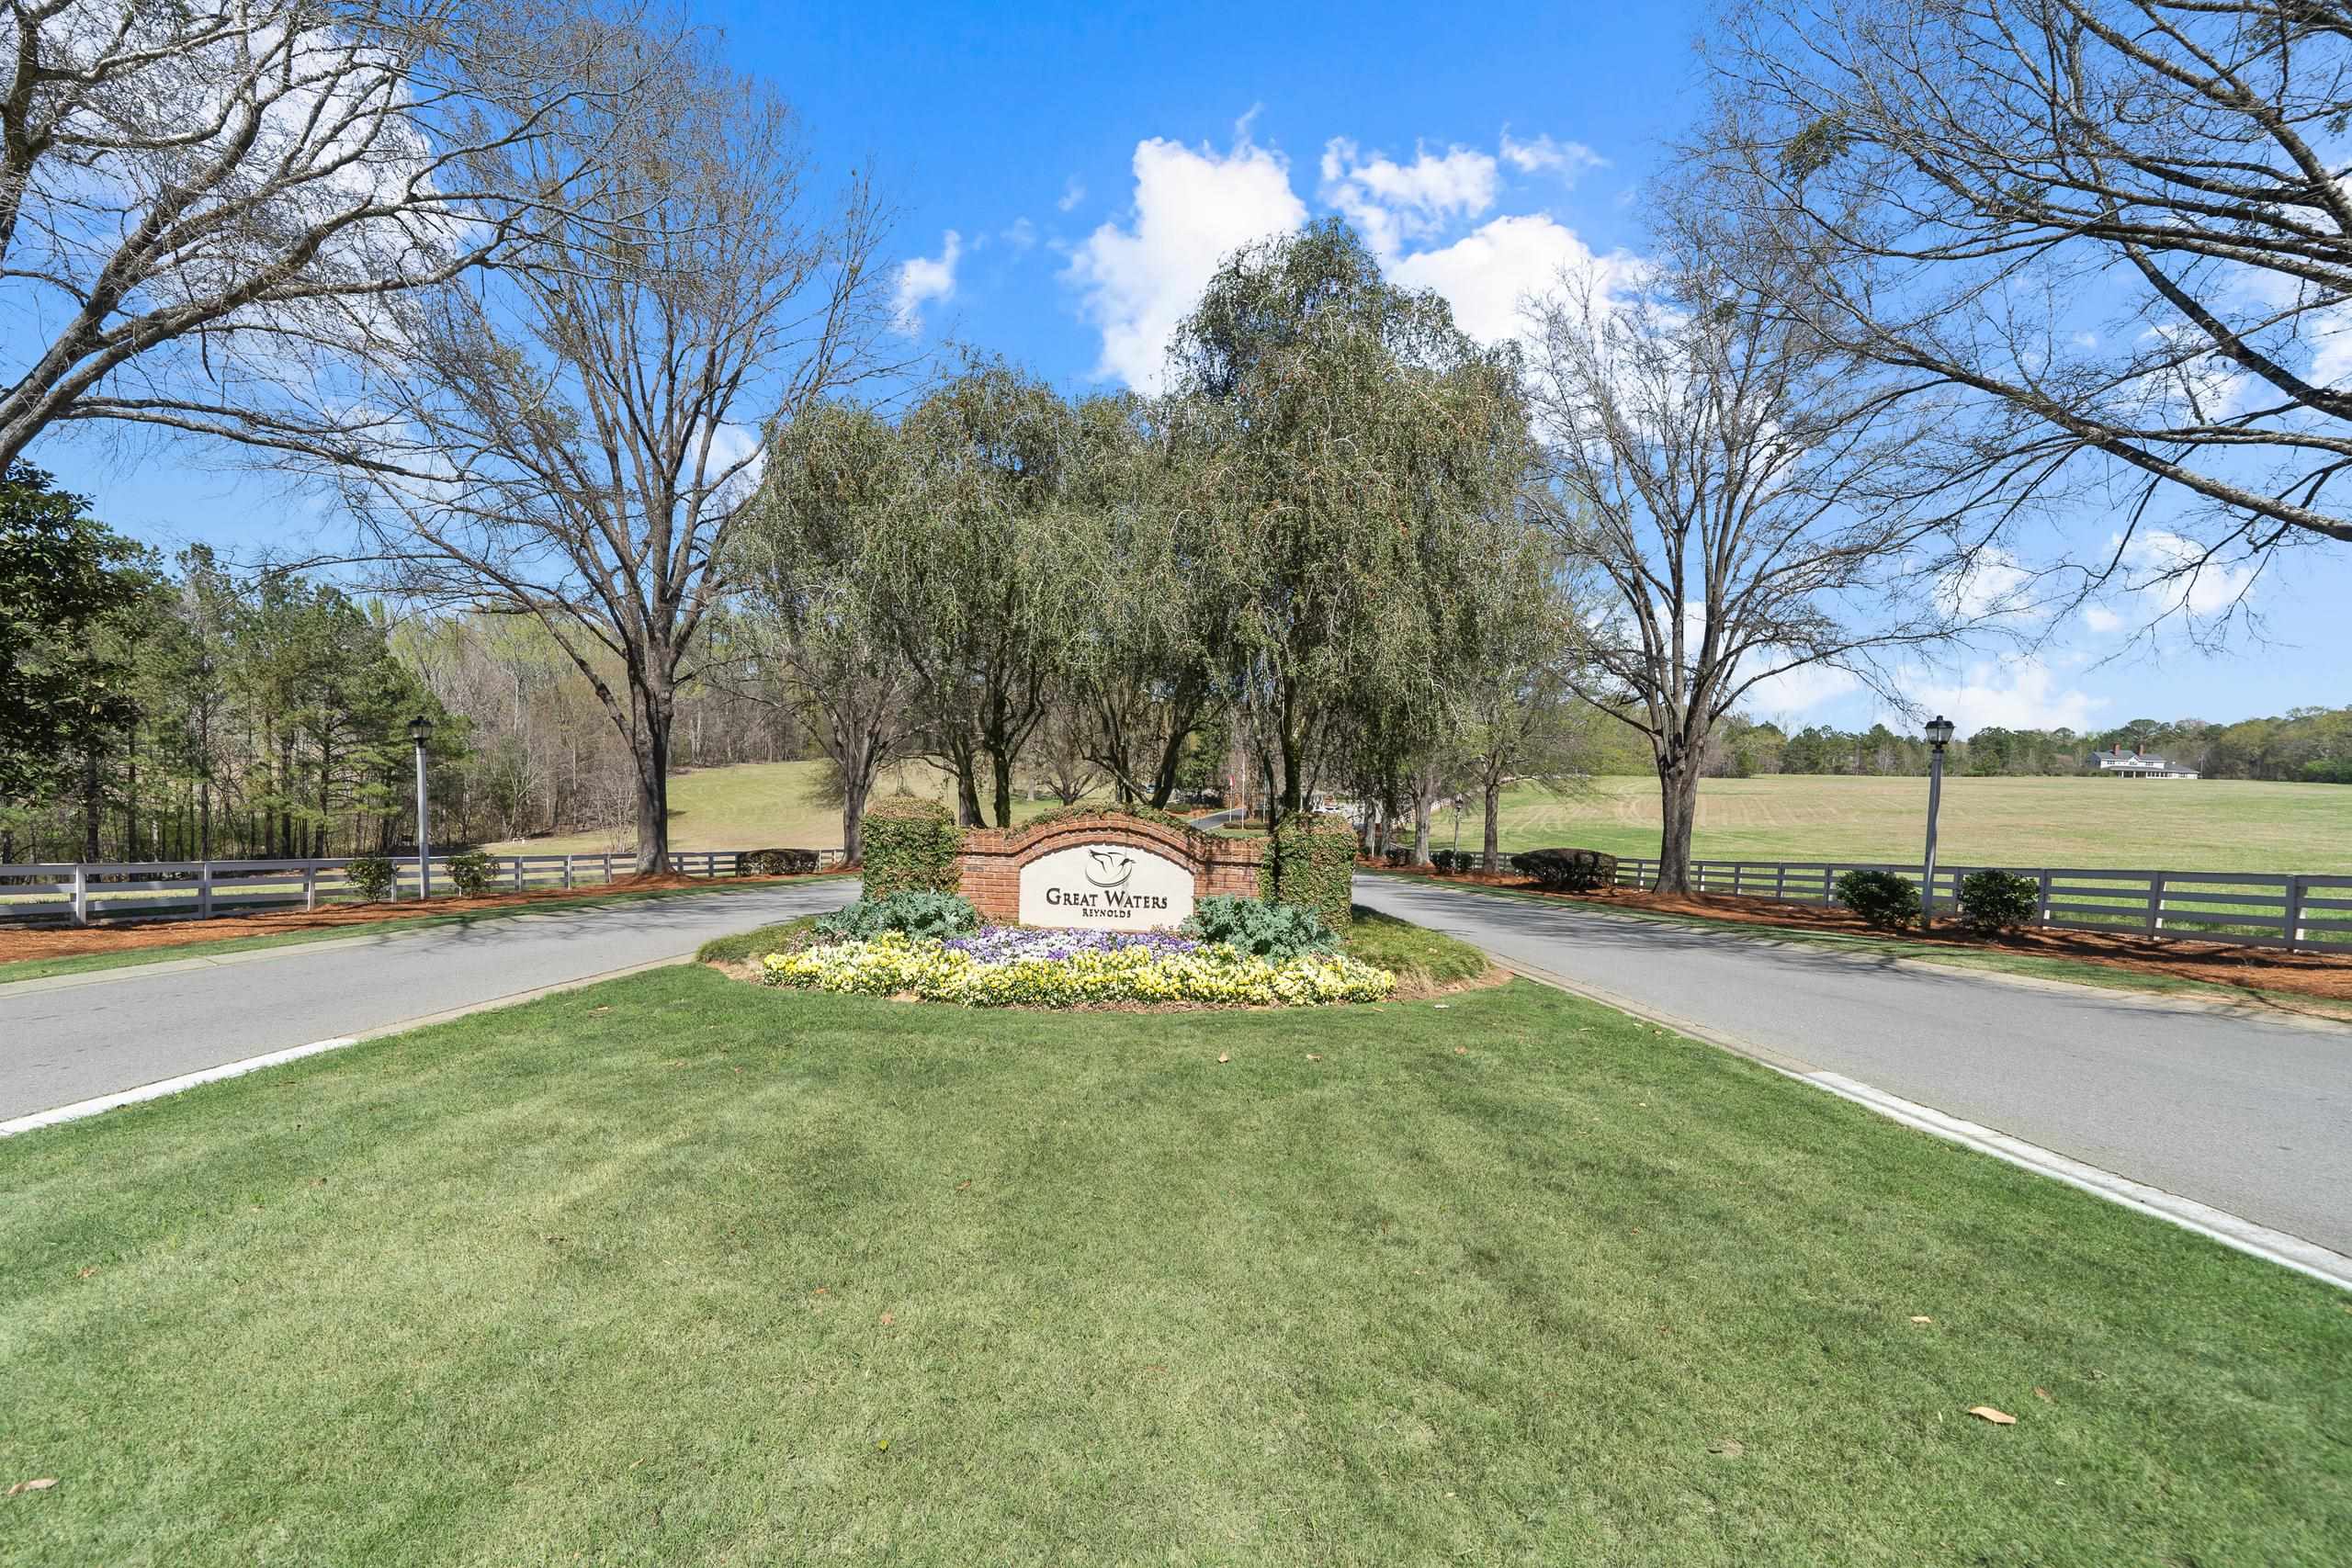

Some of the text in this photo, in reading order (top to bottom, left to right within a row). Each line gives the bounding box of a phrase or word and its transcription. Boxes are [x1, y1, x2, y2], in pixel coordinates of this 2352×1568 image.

[1046, 887, 1168, 909] GREAT WATERS
[1082, 908, 1131, 918] REYNOLDS
